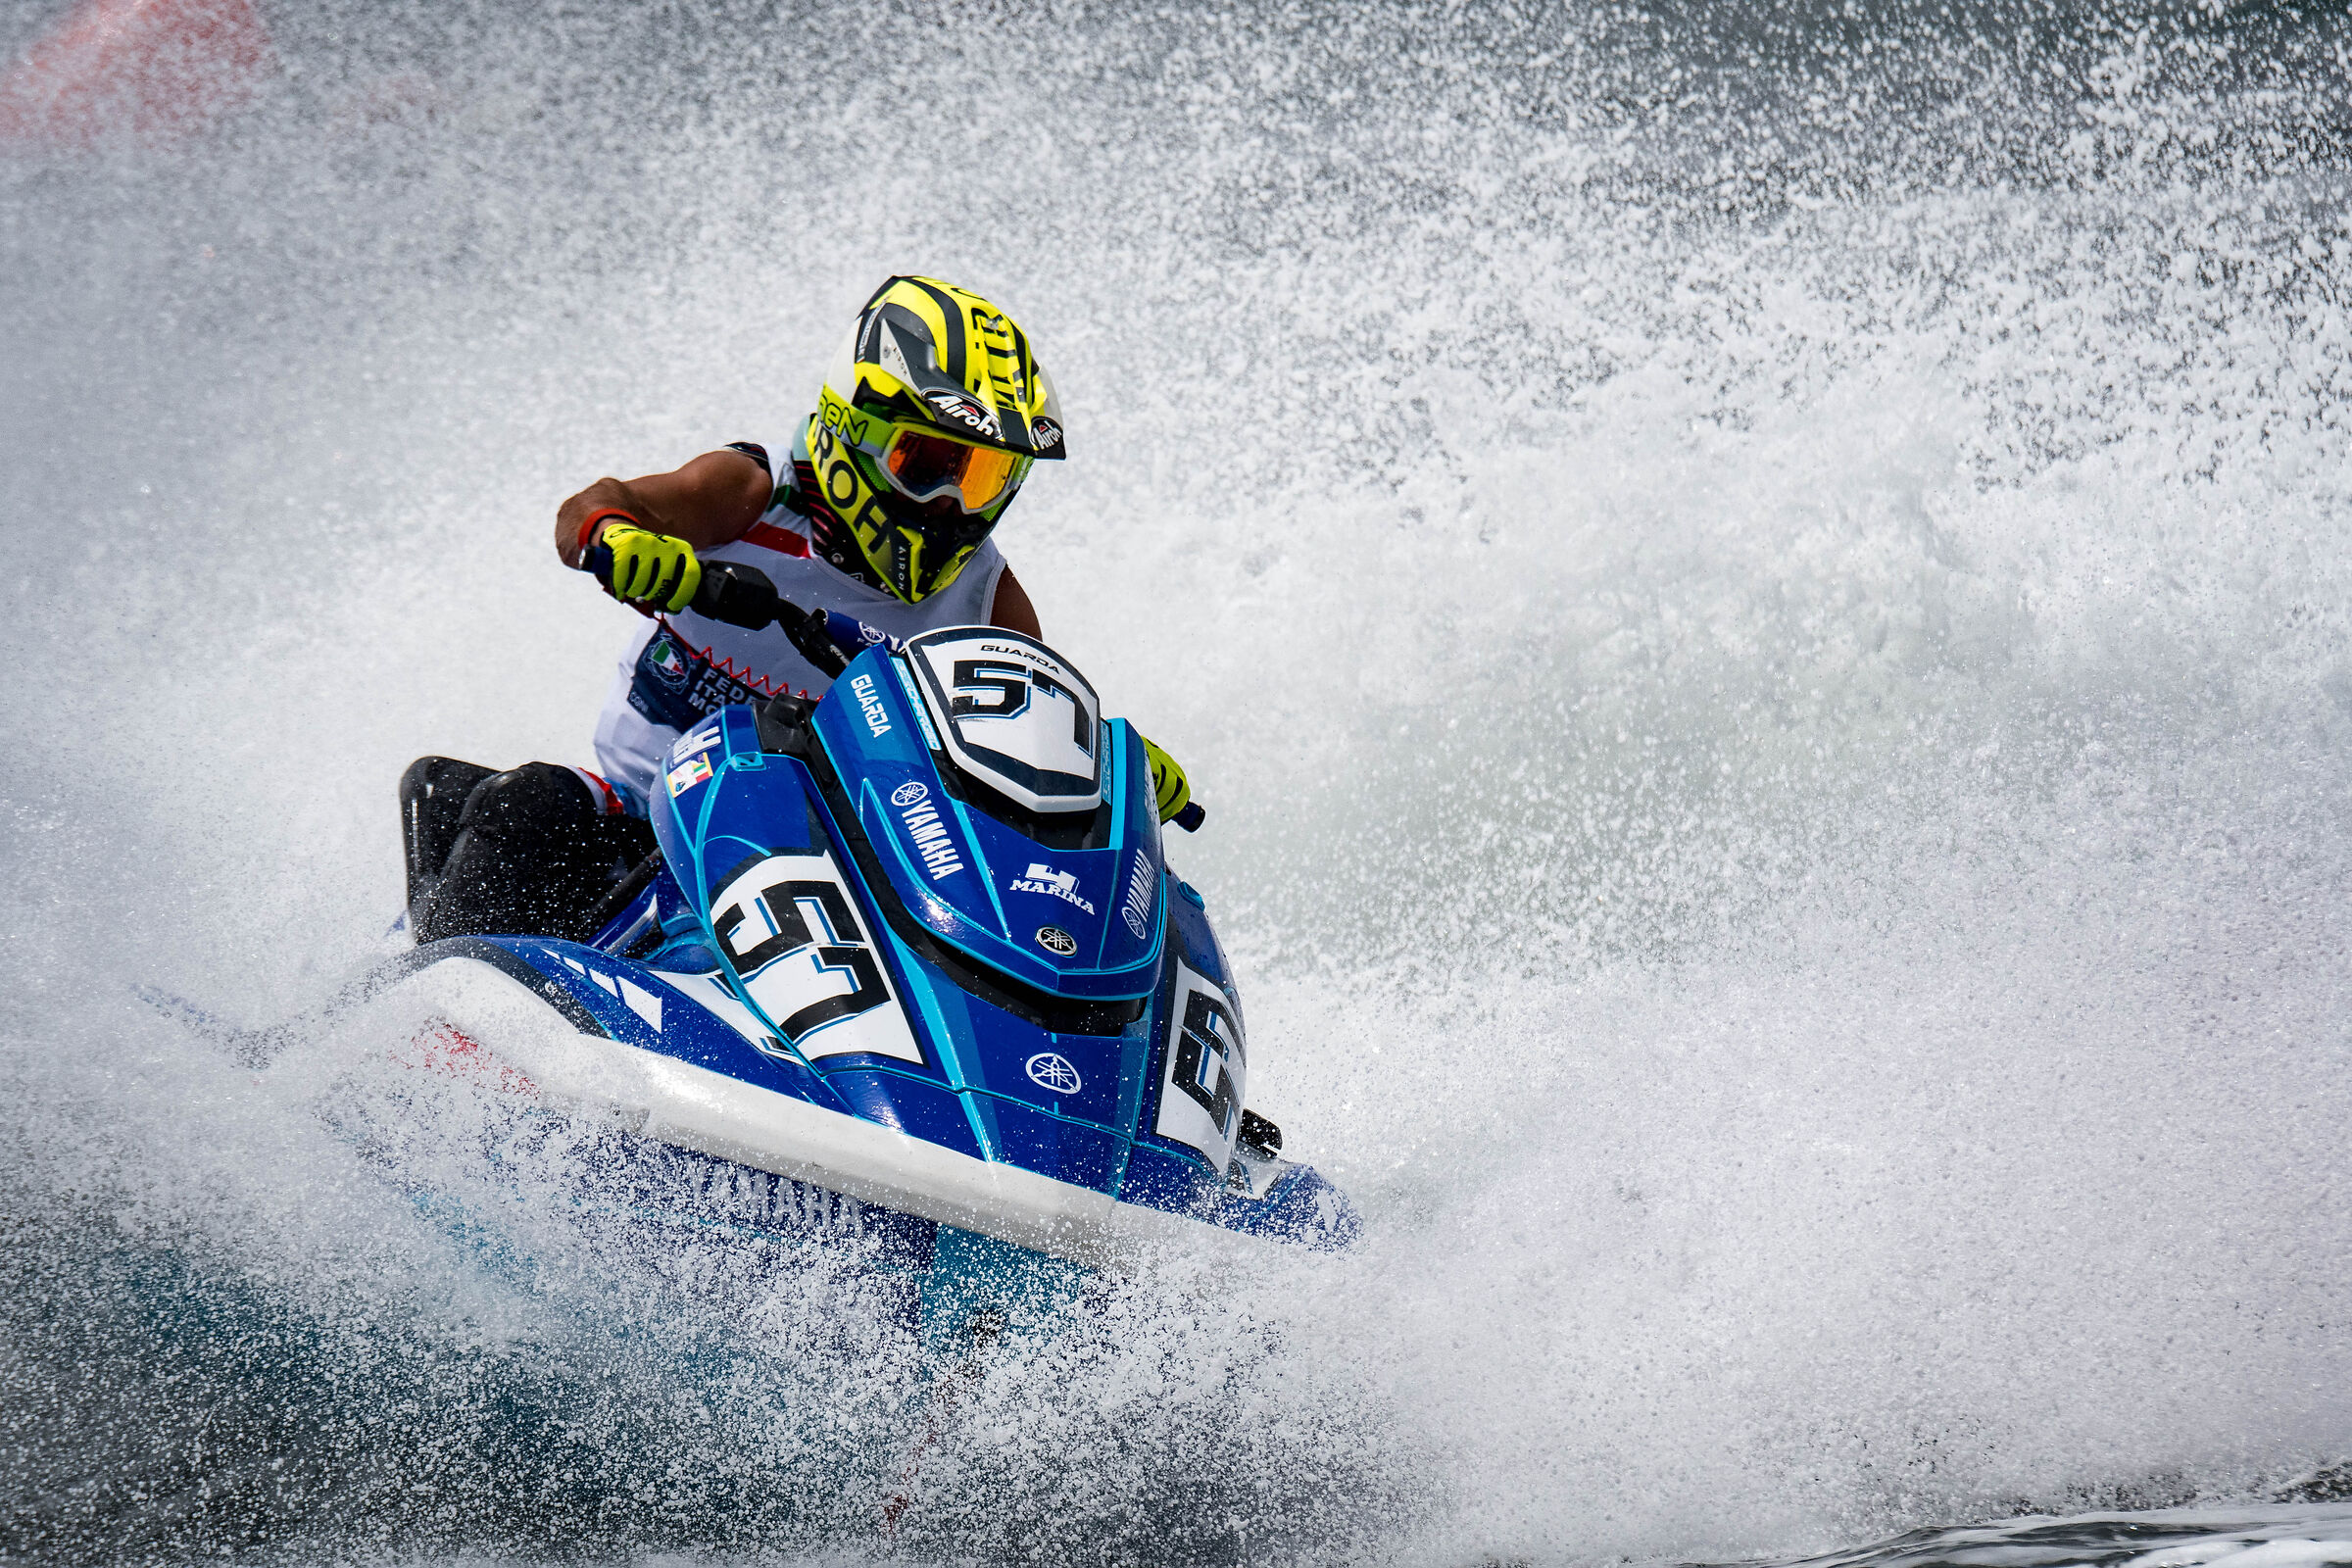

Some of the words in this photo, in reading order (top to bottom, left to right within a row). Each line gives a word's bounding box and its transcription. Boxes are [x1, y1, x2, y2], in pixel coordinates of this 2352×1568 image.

[928, 395, 994, 436] Airoh
[1032, 419, 1062, 450] Airoh
[980, 644, 1060, 675] GUARDA
[850, 673, 892, 739] GUARDA
[950, 660, 1095, 760] 57
[901, 799, 964, 880] YAMAHA
[1009, 879, 1096, 916] MARINA
[1126, 848, 1156, 923] YAMAHA
[712, 880, 892, 1053] 57
[686, 1154, 864, 1237] YAMAHA
